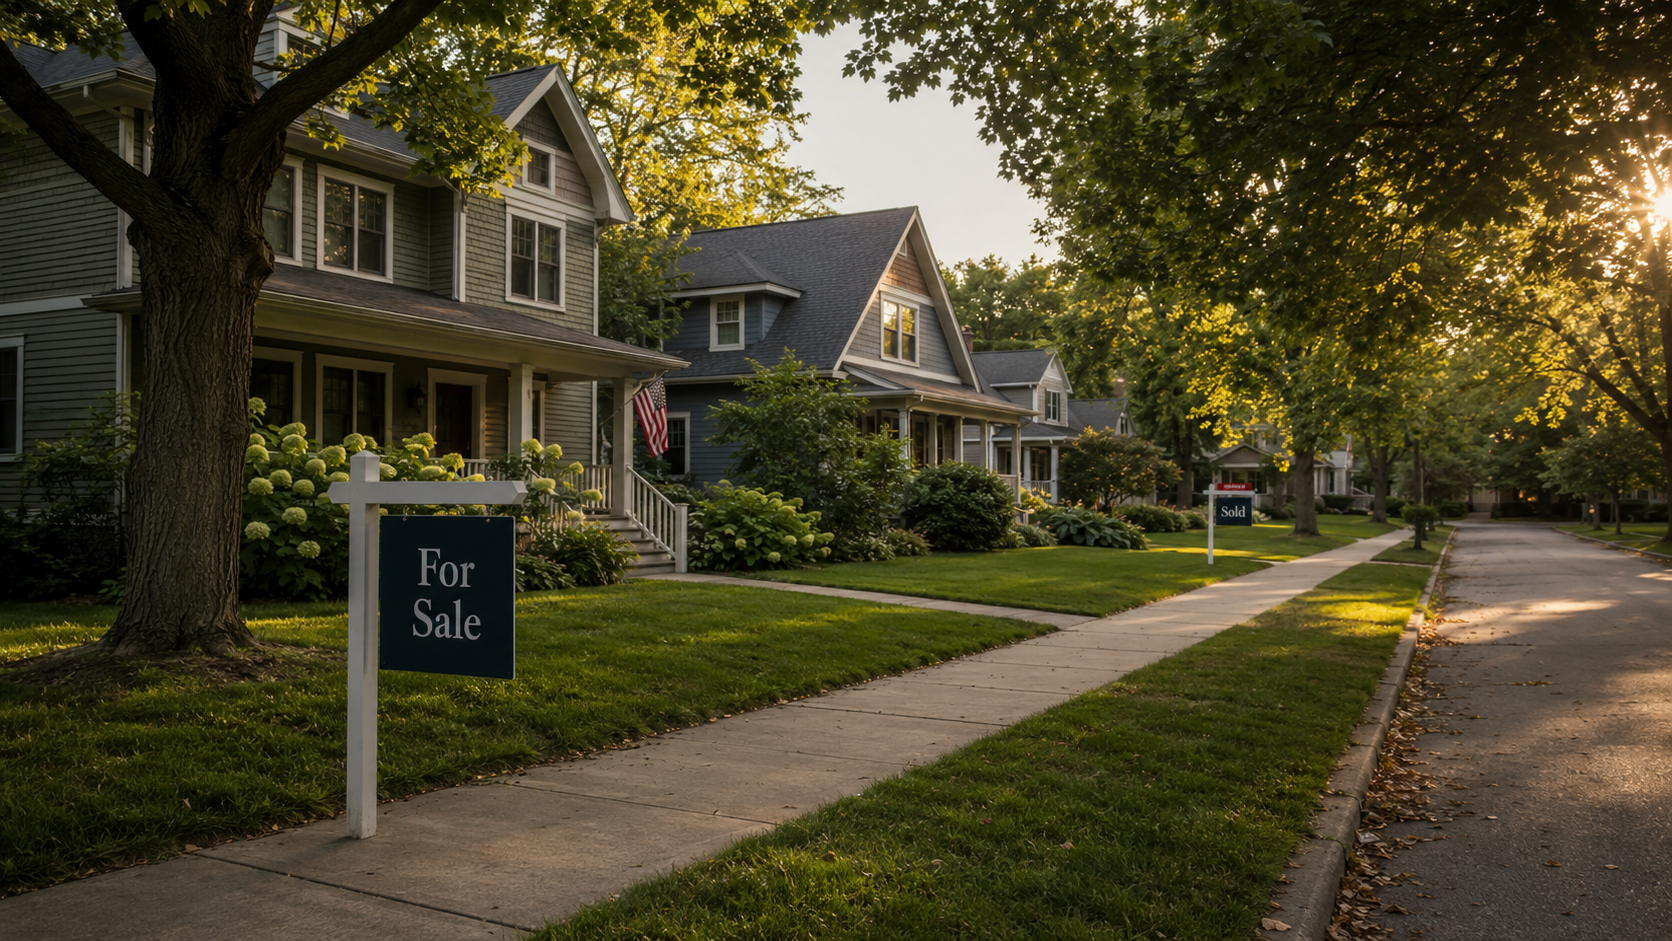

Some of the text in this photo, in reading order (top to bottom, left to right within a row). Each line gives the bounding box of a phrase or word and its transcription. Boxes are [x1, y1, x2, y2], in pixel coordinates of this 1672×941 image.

[1221, 505, 1246, 518] Sold
[418, 548, 475, 588] For
[412, 598, 481, 640] Sale
